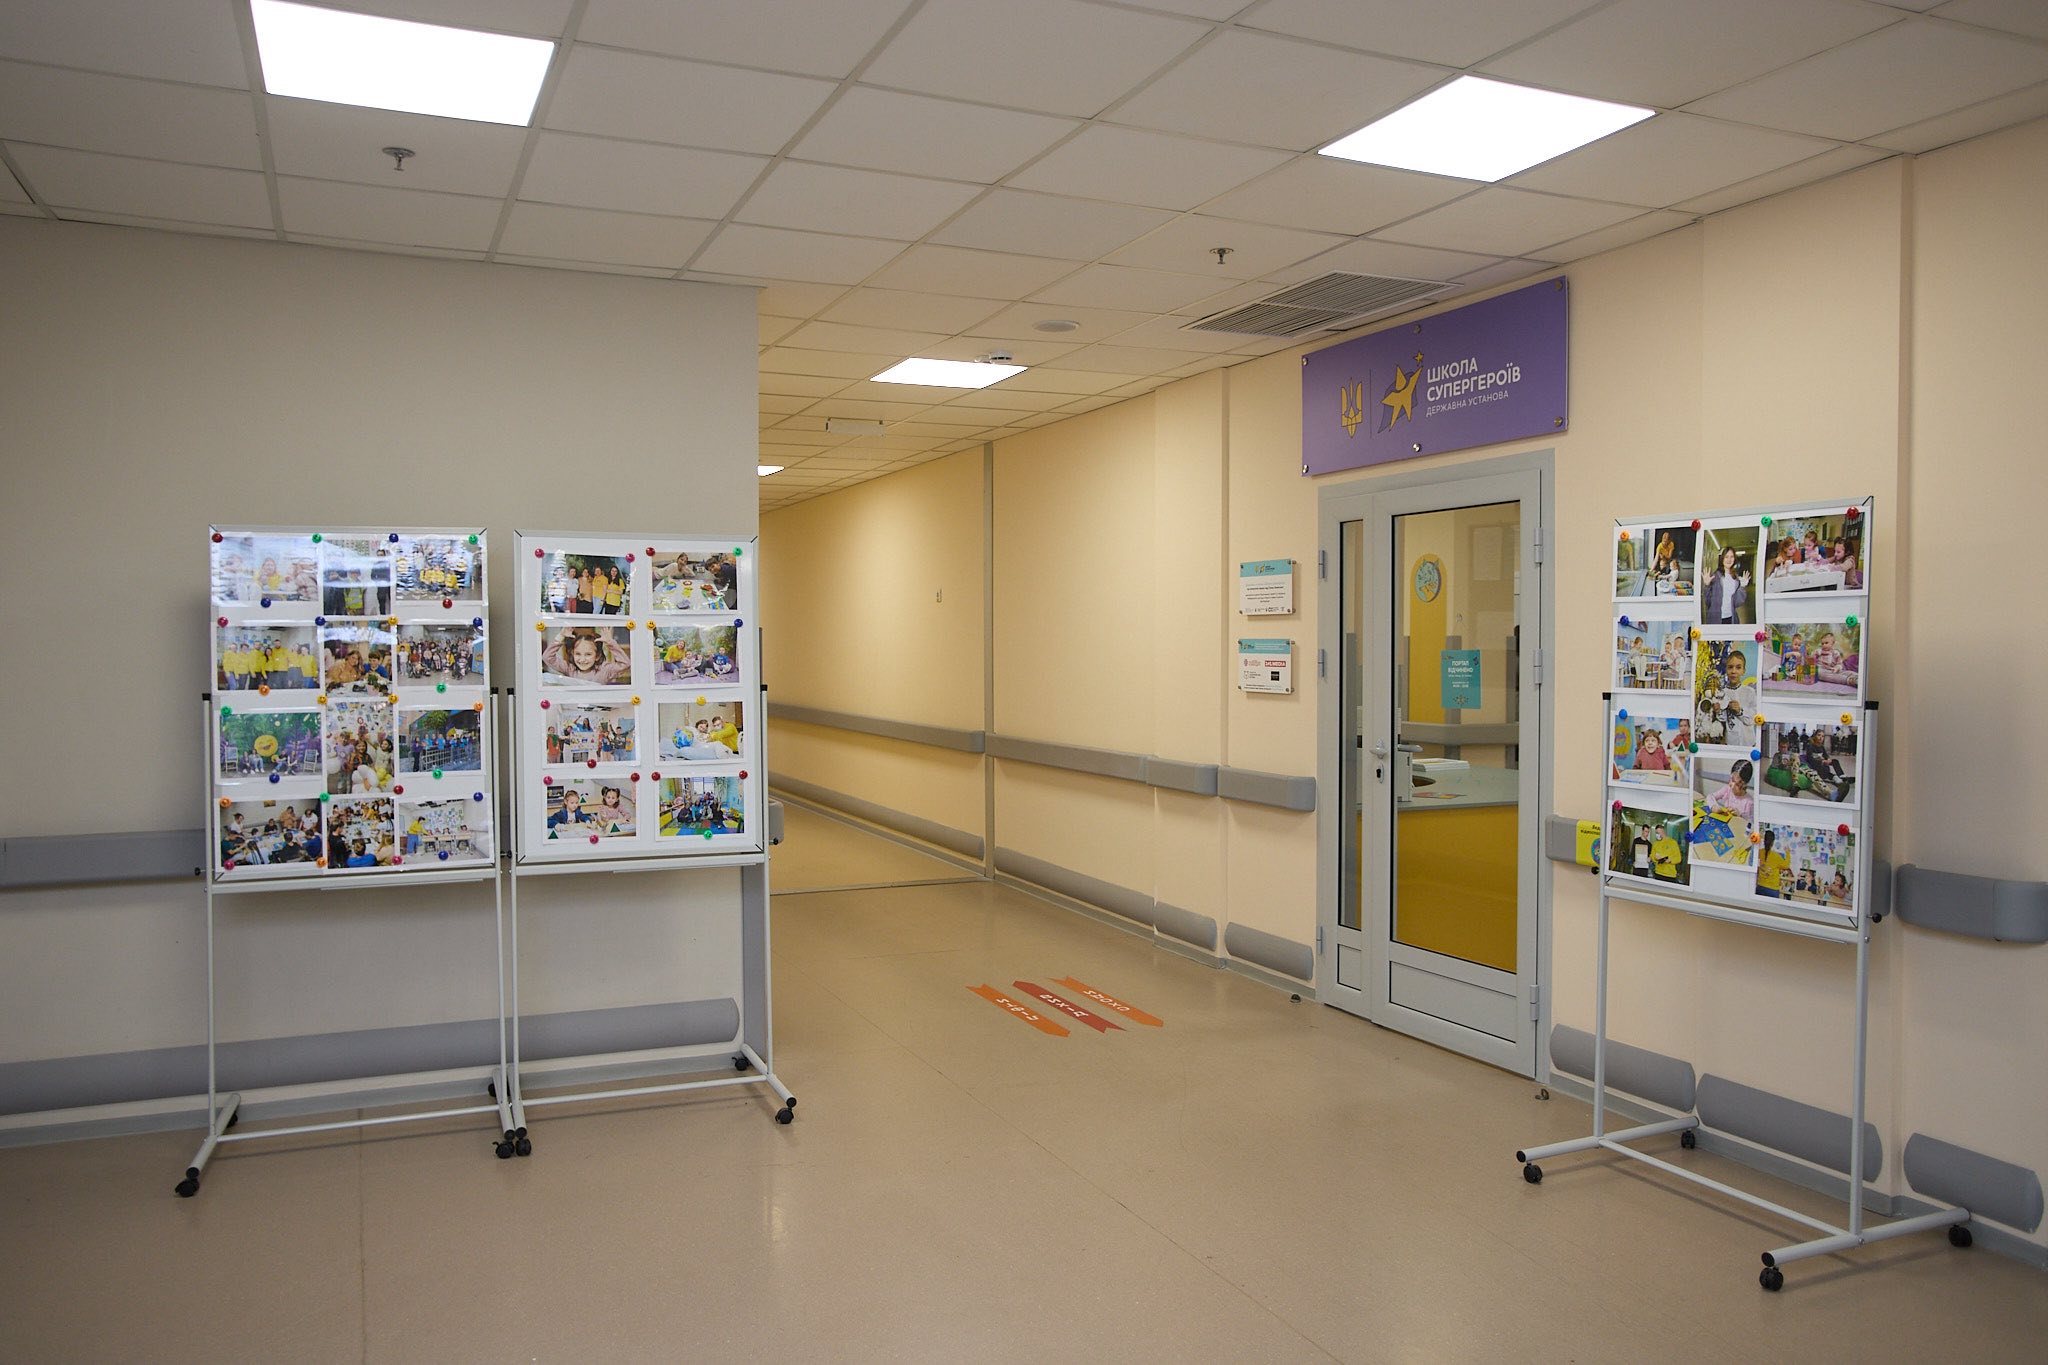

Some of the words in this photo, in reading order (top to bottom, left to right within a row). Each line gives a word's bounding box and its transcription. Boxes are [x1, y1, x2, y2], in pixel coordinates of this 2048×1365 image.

[1426, 362, 1521, 402] СУПЕРГЕРОЇВ
[1427, 357, 1478, 383] ШКОЛА
[1425, 399, 1467, 418] ДЕРЖАВНА
[1468, 390, 1509, 407] УСТАНОВА
